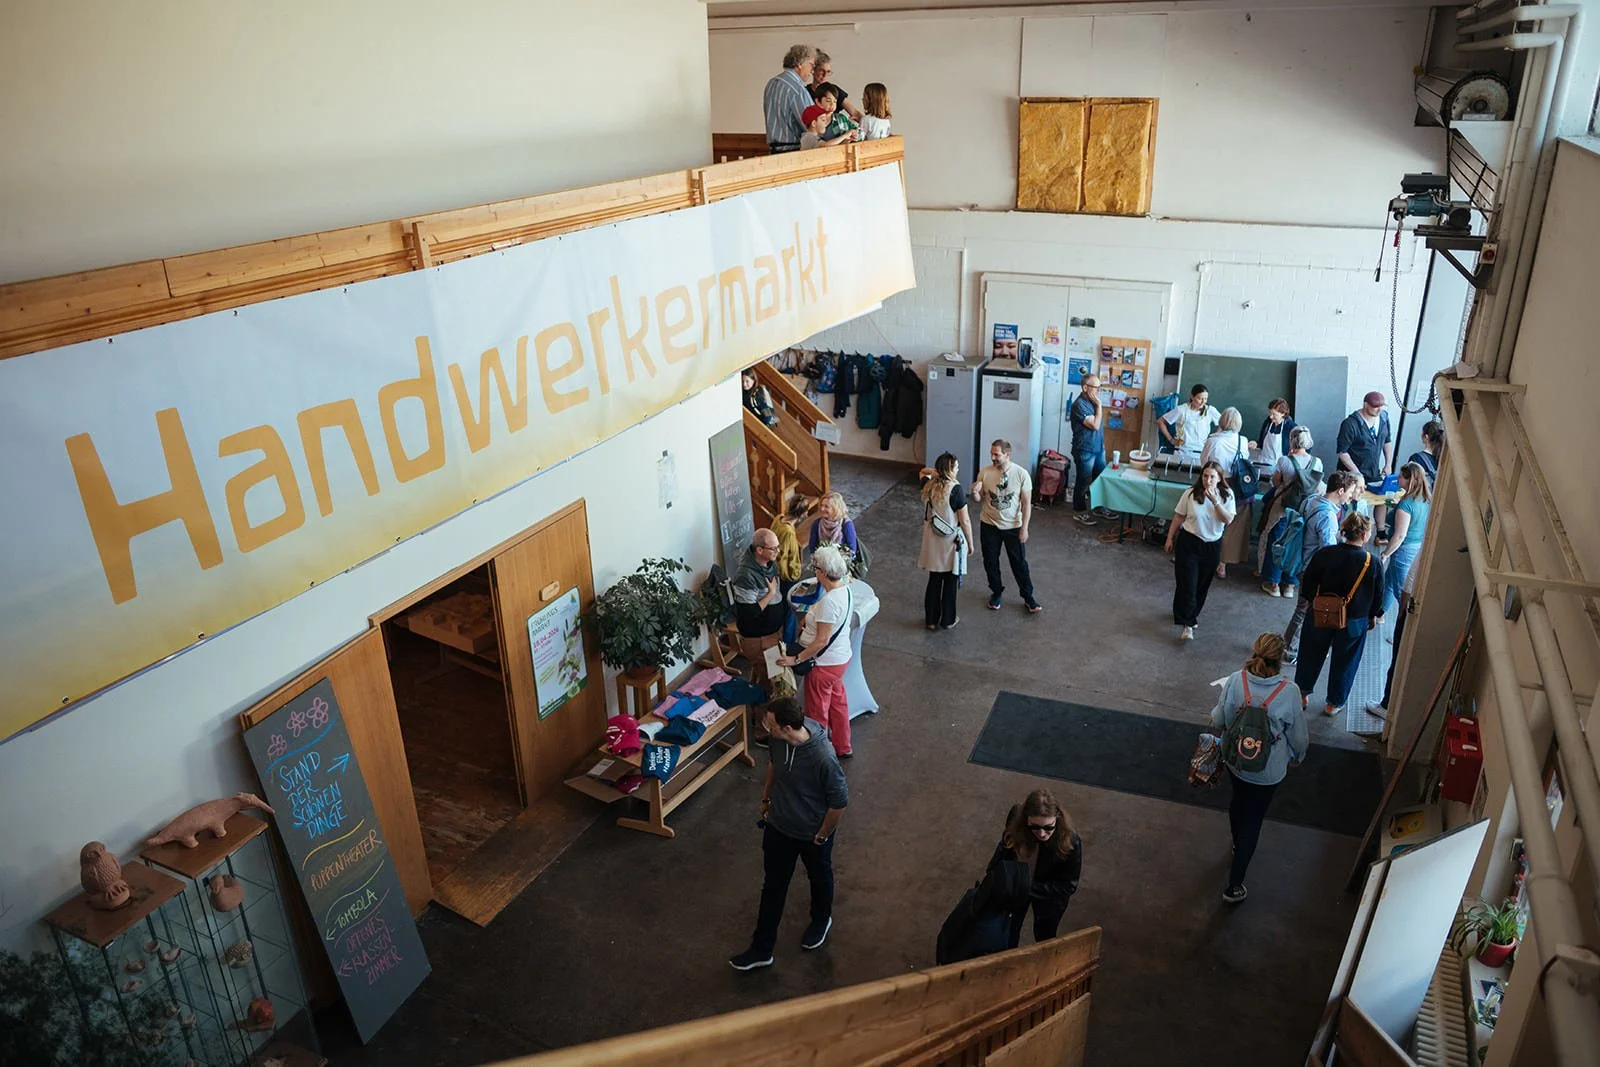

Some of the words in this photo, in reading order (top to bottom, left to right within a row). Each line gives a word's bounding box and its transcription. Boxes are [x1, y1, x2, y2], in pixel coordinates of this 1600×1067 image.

[65, 215, 830, 605] Handwerkermarkt
[280, 752, 320, 791] STAND
[288, 780, 319, 808] DER
[293, 781, 342, 829] SCHÖNEN
[306, 800, 348, 839] DINGE
[309, 829, 383, 892] PUPPENTHEATER
[366, 945, 404, 986] ZIMMER
